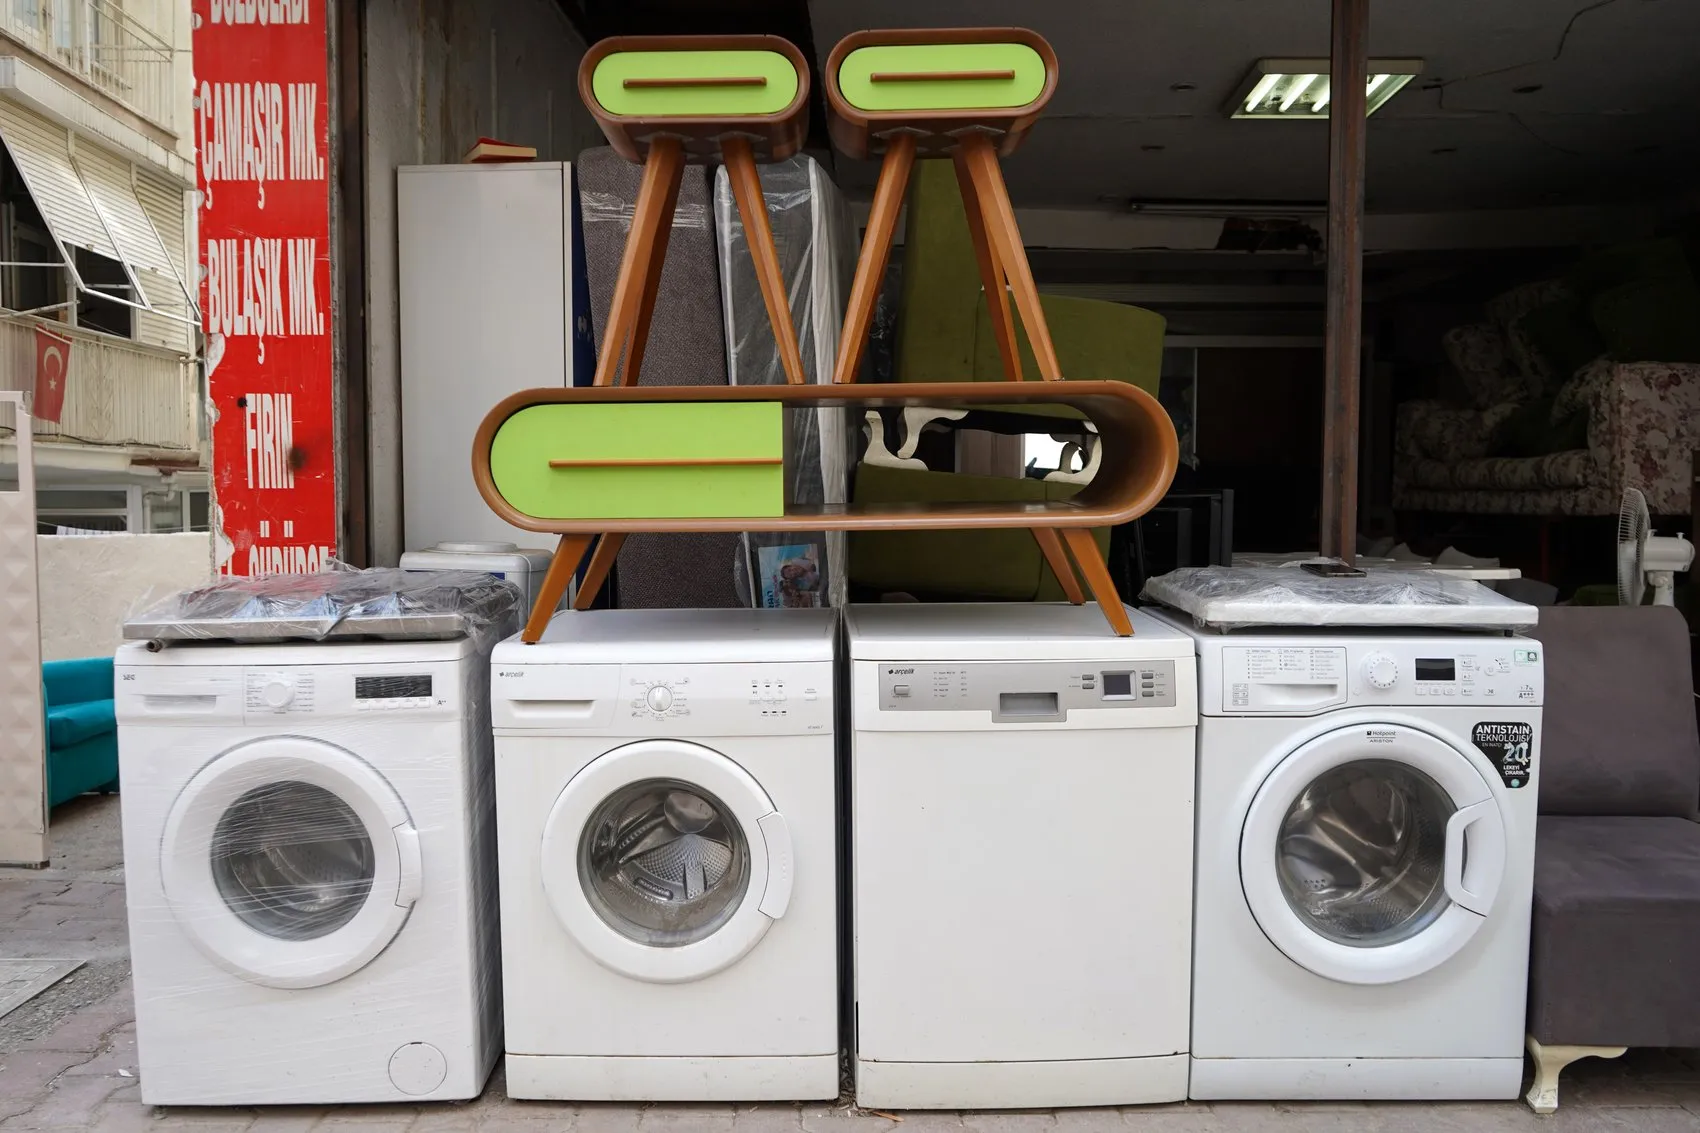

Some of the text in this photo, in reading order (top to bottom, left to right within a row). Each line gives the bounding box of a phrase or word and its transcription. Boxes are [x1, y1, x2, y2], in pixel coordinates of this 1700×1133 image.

[199, 80, 325, 210] ÇAMAŞIR MK.
[206, 238, 325, 364] BULAŞIK MK.
[245, 392, 295, 490] FIRIN
[1476, 724, 1530, 735] ANTISTAIN
